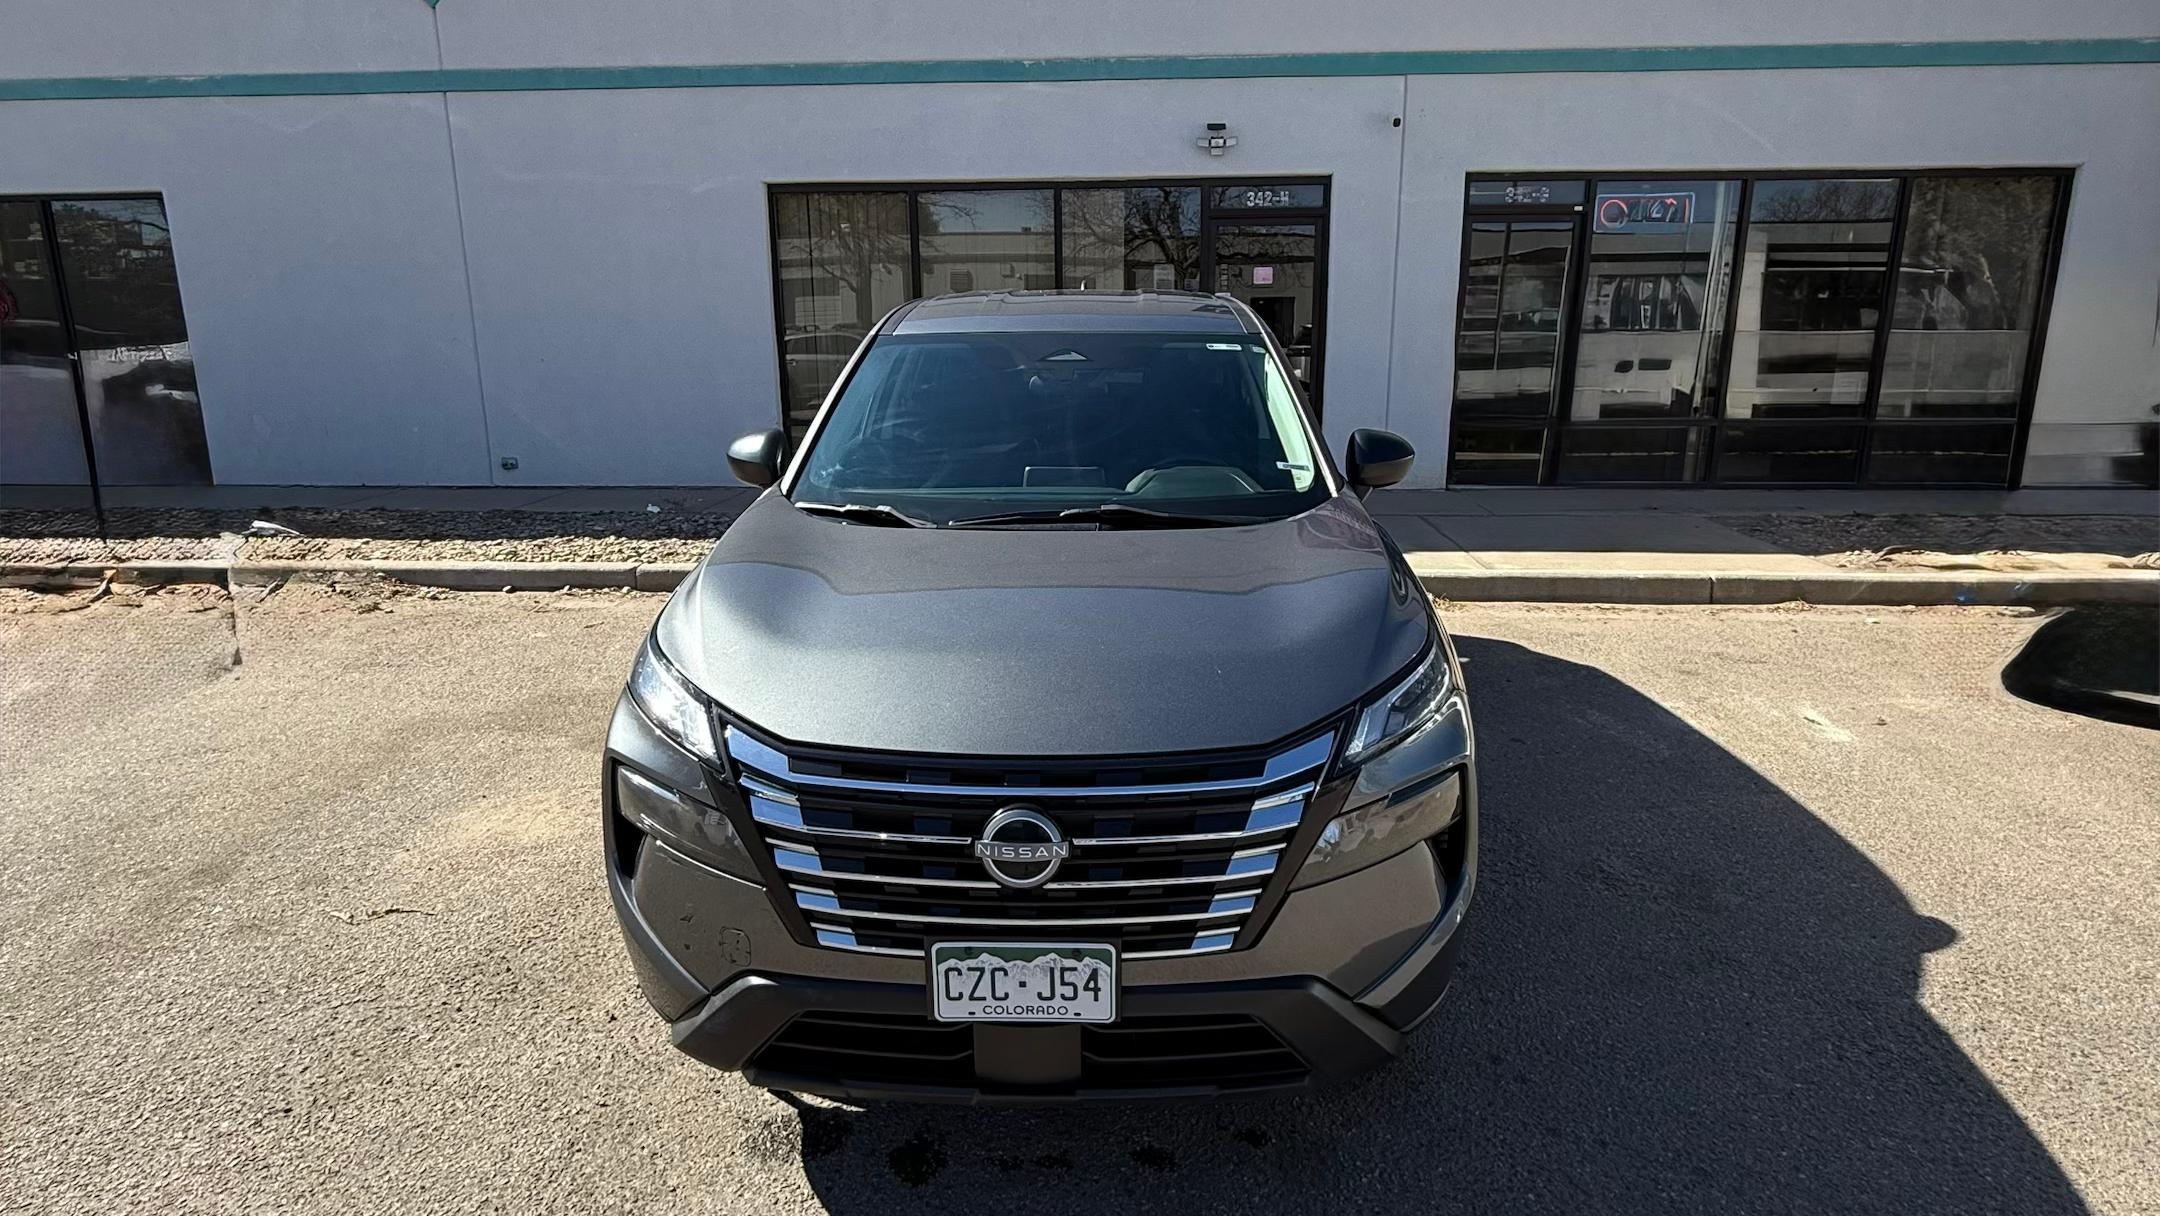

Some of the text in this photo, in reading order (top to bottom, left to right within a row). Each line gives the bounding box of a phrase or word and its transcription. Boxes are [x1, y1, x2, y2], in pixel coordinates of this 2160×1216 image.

[1247, 191, 1289, 206] 342-H
[977, 844, 1066, 858] NISSAN
[982, 1005, 1069, 1016] COLORADO
